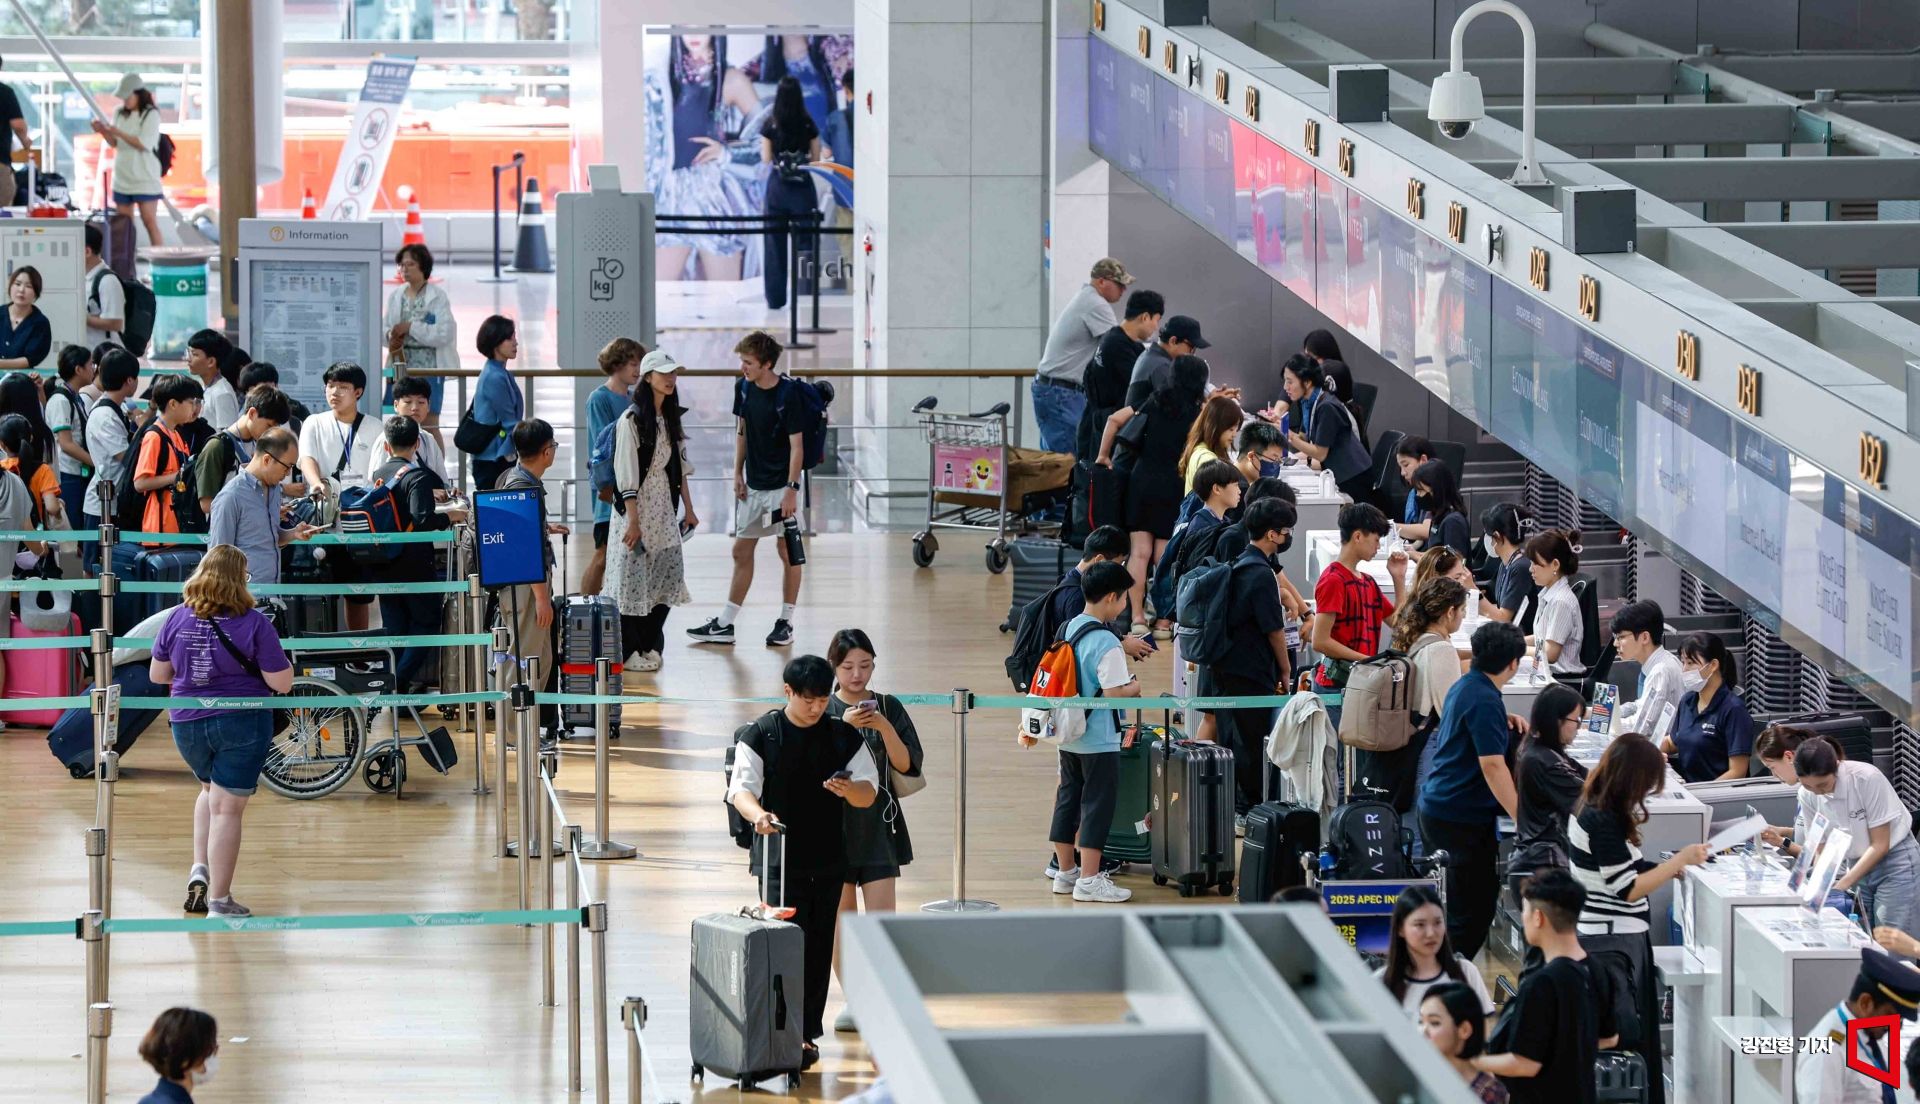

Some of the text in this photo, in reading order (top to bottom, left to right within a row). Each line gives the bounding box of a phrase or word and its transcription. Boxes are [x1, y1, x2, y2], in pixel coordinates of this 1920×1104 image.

[1407, 178, 1425, 219] D26
[289, 229, 349, 241] Information
[1448, 201, 1466, 243] D27
[594, 280, 610, 294] kg
[798, 256, 853, 280] Inch
[1530, 246, 1549, 291] D28
[1579, 274, 1599, 321] D29
[1676, 329, 1699, 381] D30
[1737, 363, 1762, 417] D31
[1859, 430, 1888, 490] D32
[489, 494, 517, 502] UNITED
[482, 532, 505, 545] Exit
[242, 700, 263, 708] Airport
[1364, 813, 1385, 874] AZER
[1330, 895, 1355, 904] 2025
[1357, 895, 1382, 904] APEC
